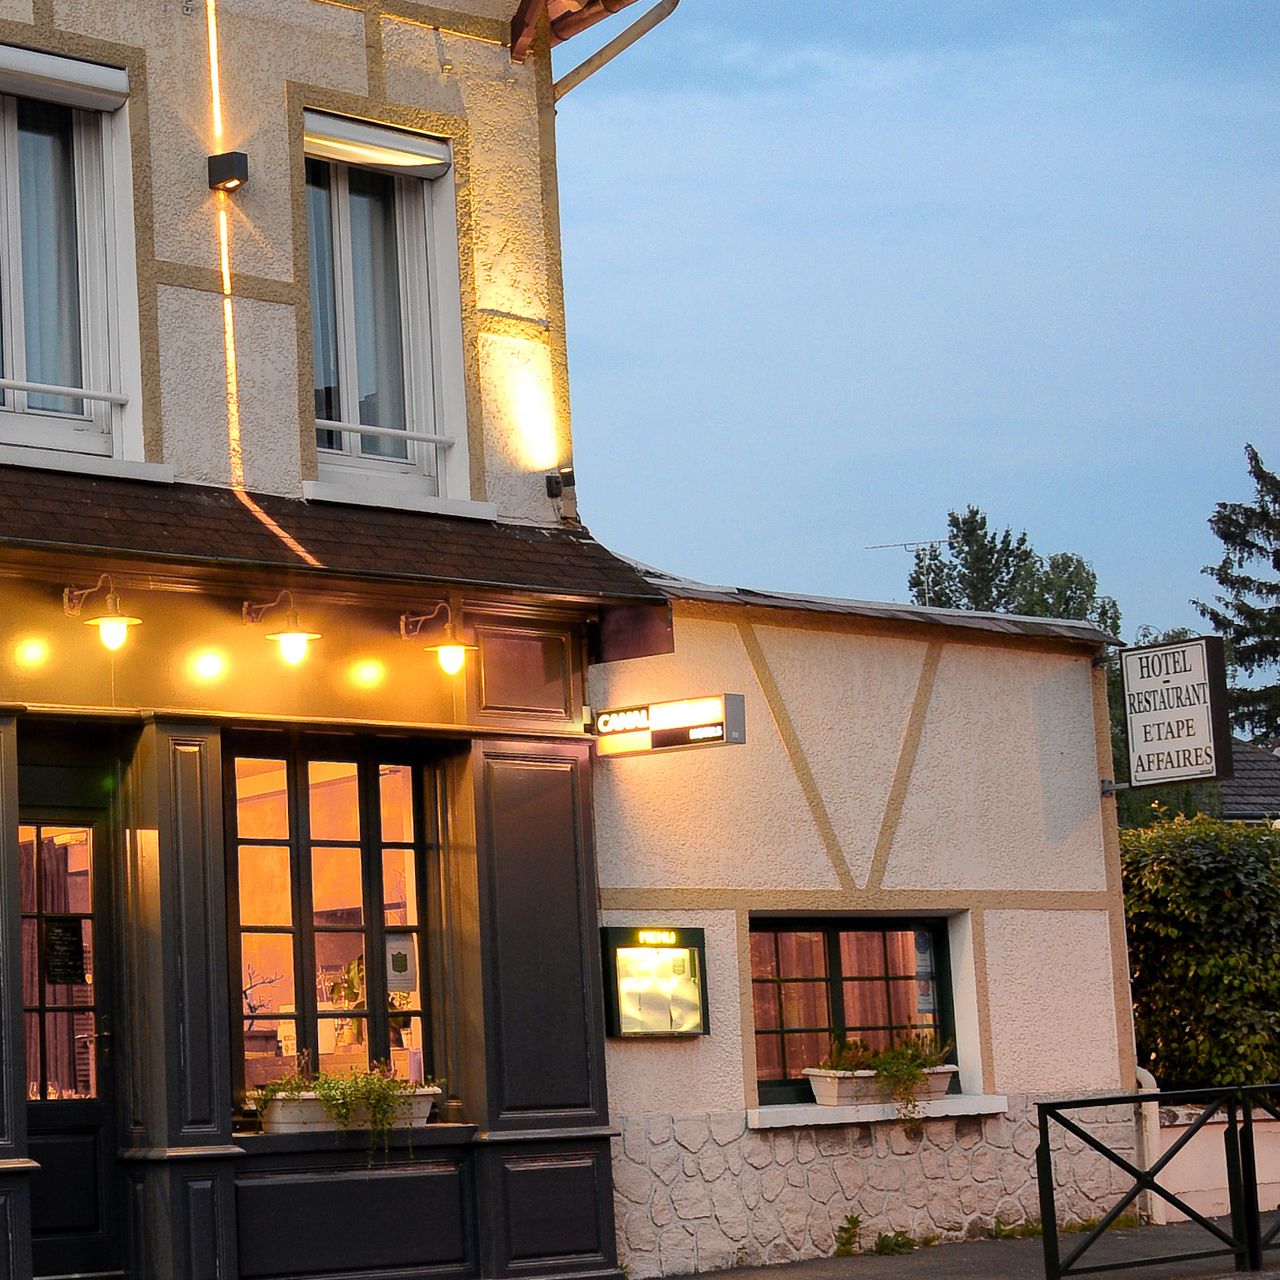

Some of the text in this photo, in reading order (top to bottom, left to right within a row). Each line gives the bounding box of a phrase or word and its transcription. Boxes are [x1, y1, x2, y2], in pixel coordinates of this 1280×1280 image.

[1138, 650, 1192, 680] HOTEL
[1128, 682, 1208, 715] RESTAURANT
[1142, 718, 1196, 743] ETAPE
[1135, 746, 1213, 773] AFFAIRES
